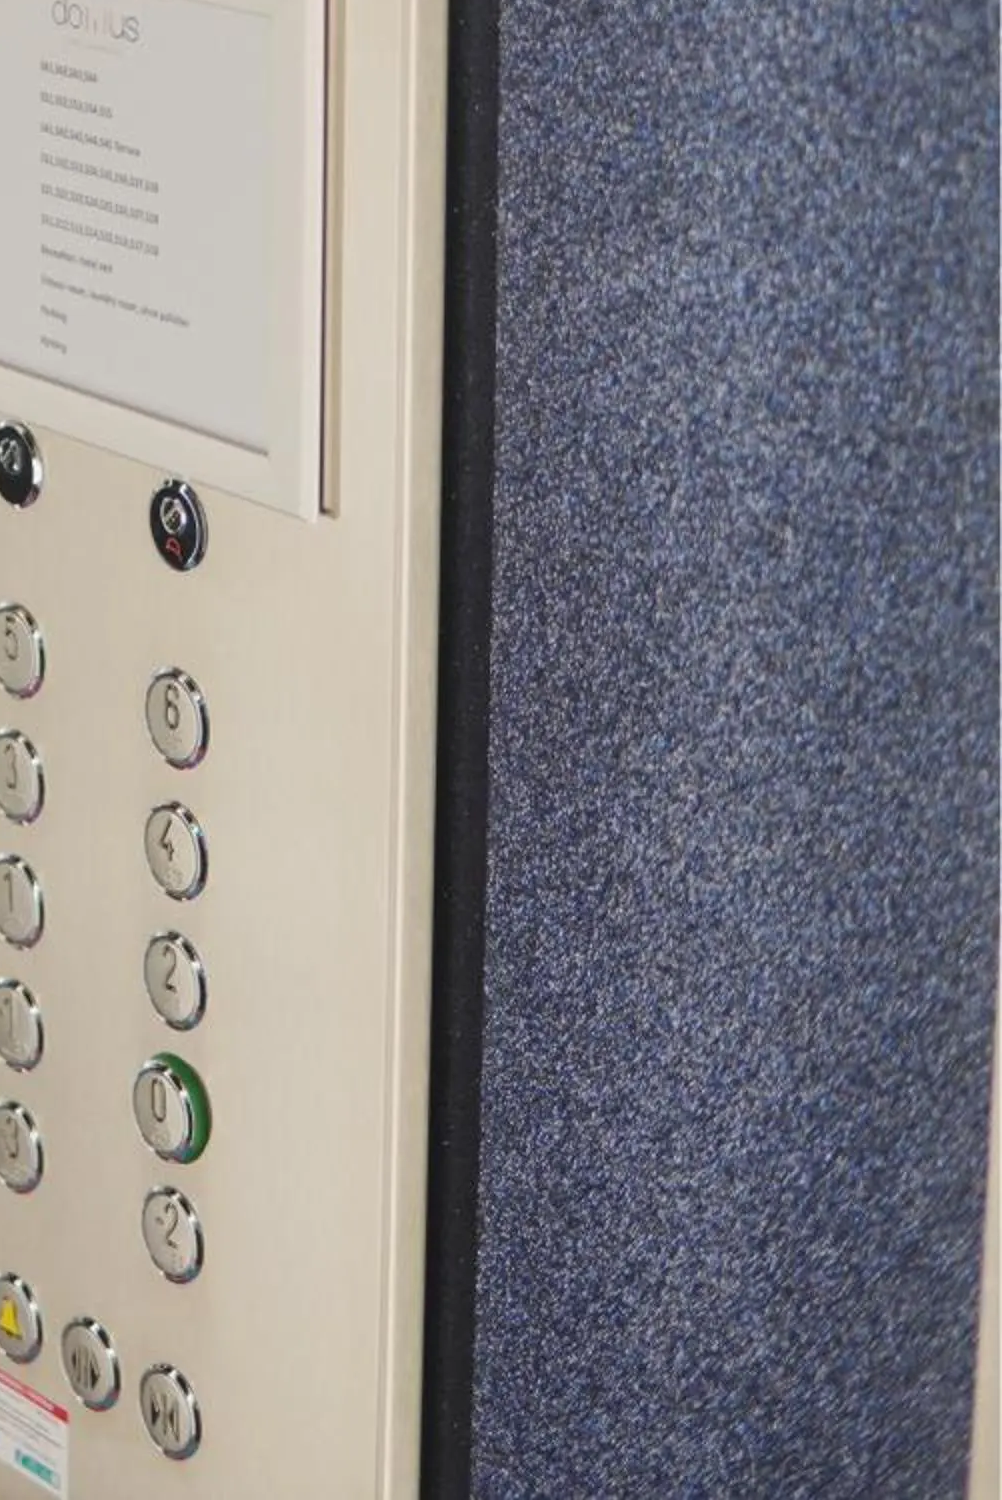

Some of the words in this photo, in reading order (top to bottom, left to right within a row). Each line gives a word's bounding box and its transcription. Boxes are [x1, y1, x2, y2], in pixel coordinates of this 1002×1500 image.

[5, 614, 19, 661] 5
[164, 682, 180, 730] 6
[160, 818, 175, 862] 4
[162, 945, 178, 992] 2
[151, 1077, 167, 1123] 0
